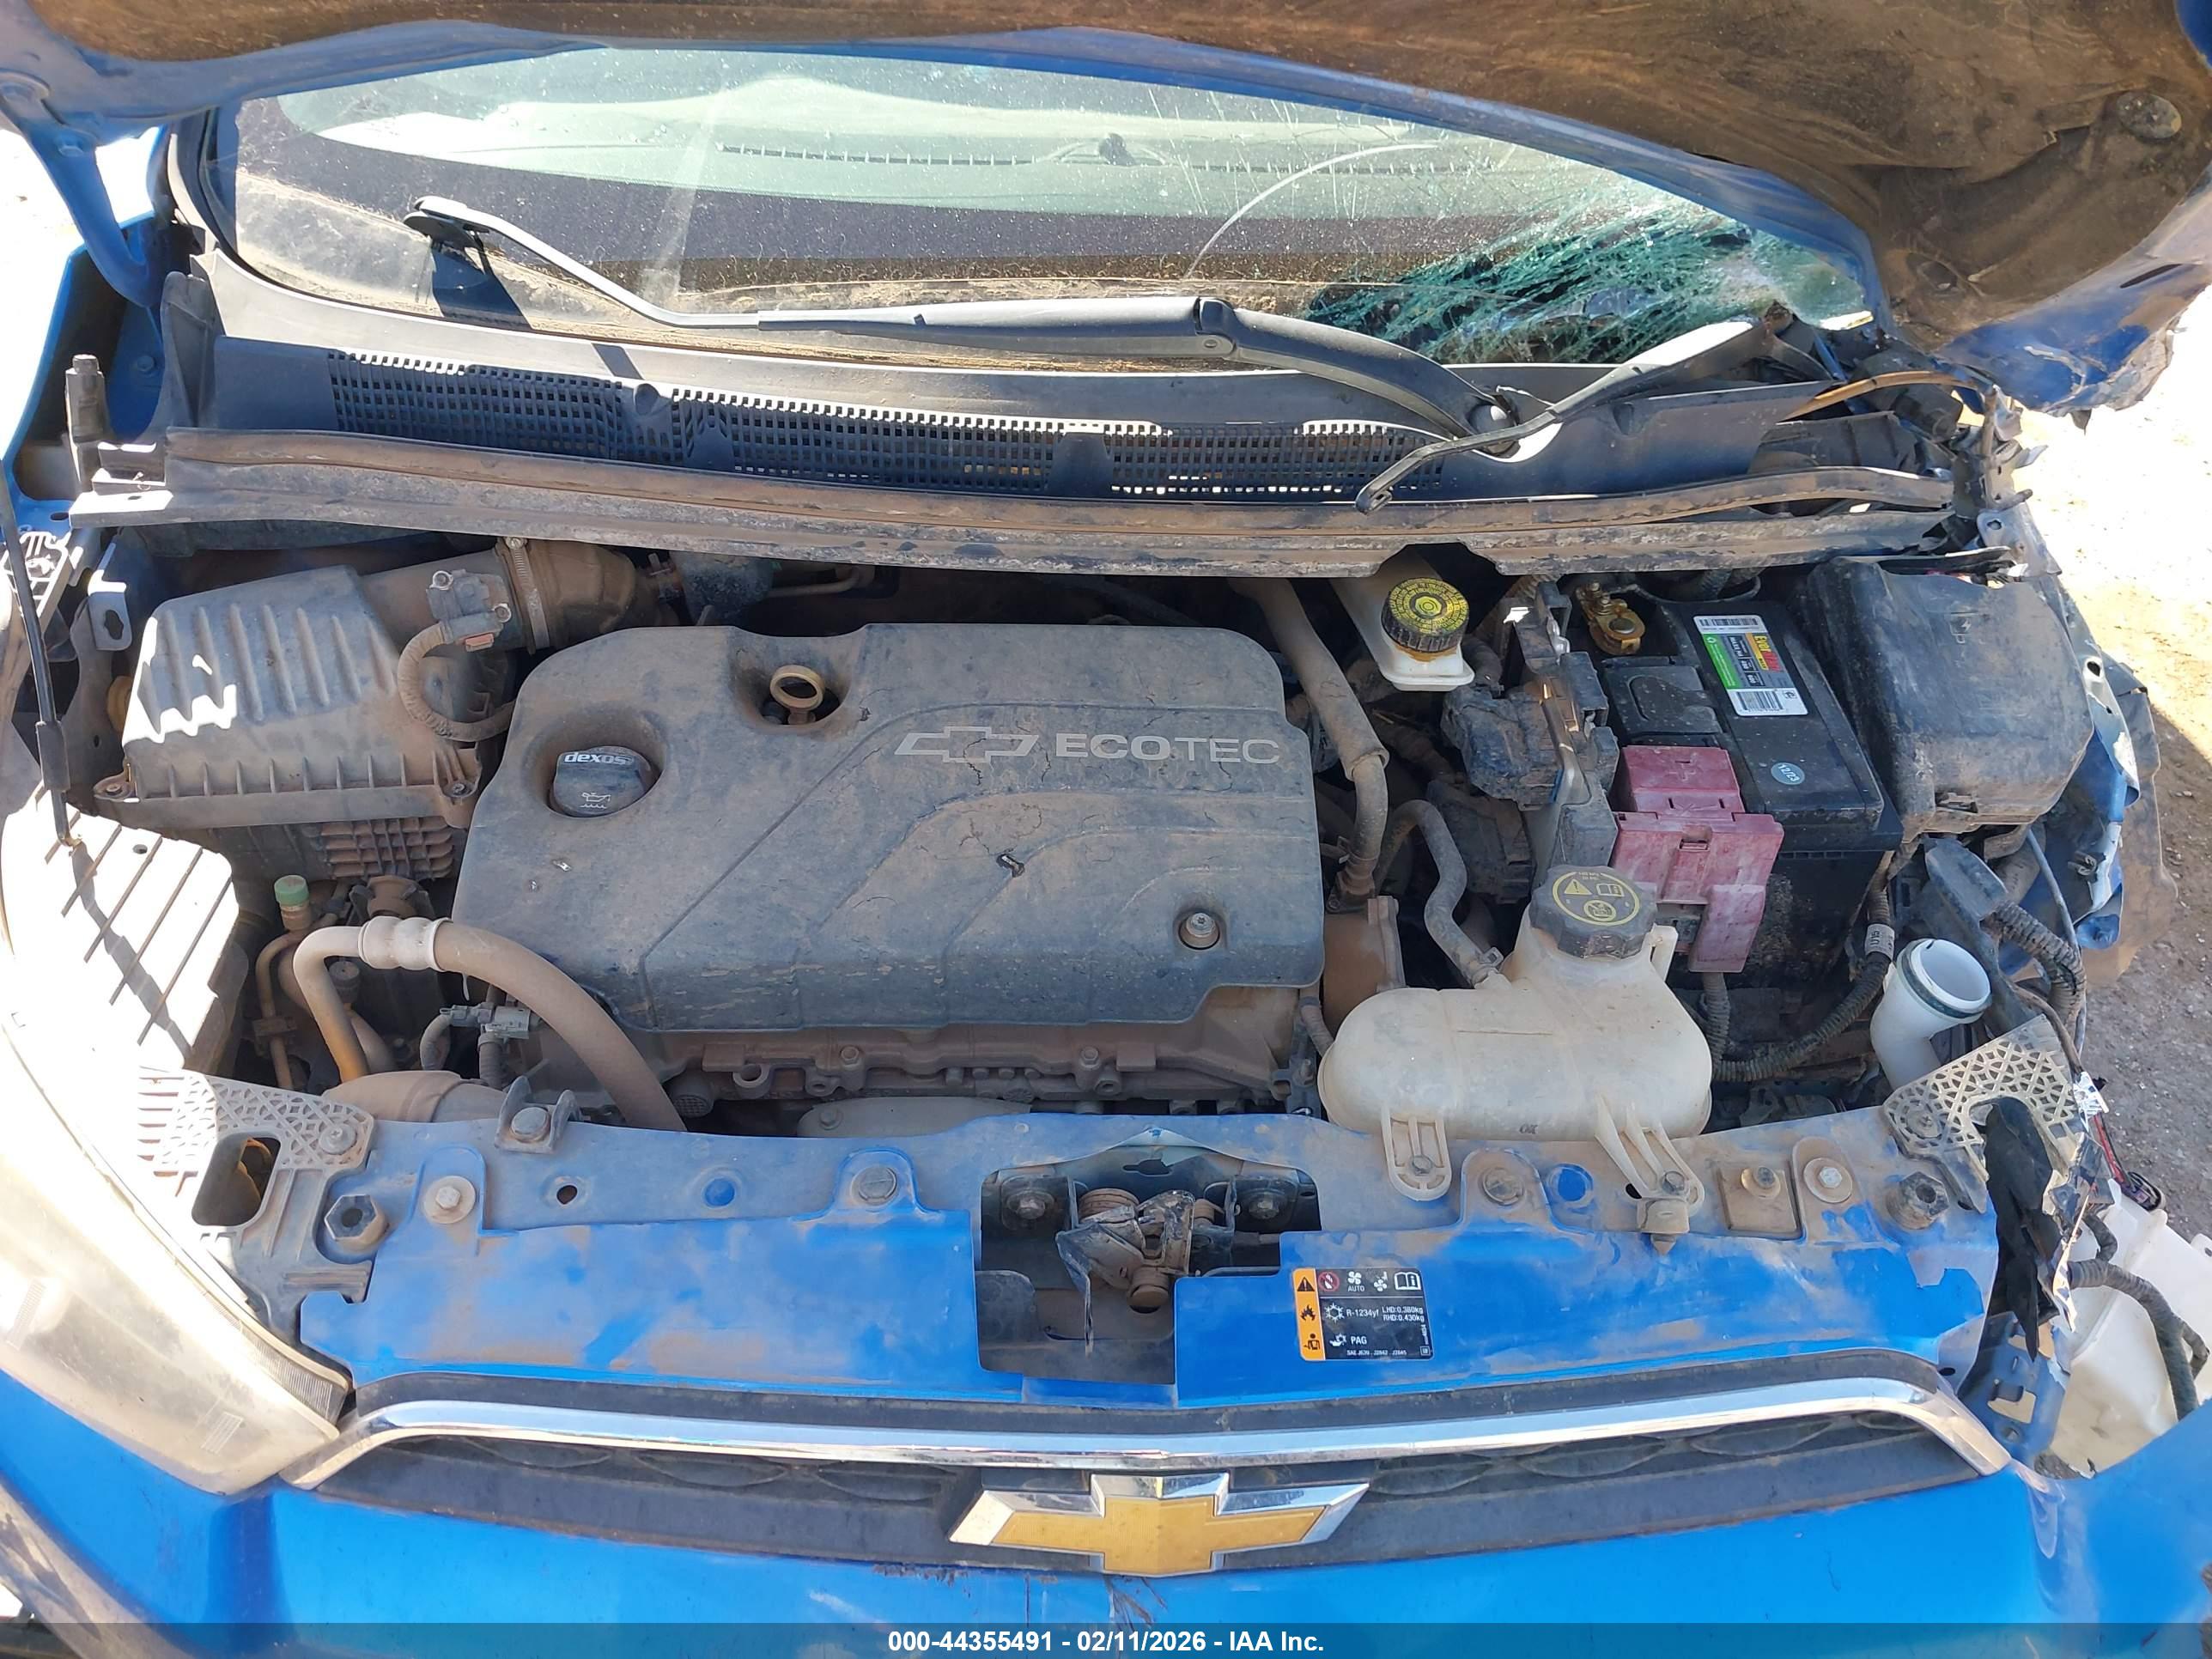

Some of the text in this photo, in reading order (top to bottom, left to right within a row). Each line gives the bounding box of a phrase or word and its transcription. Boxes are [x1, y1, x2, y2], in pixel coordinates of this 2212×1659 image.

[1055, 732, 1280, 764] ECOTEC
[564, 752, 633, 764] dexos
[1778, 764, 1801, 781] 12/23
[1346, 1309, 1378, 1317] R-1234yf
[1351, 1336, 1367, 1345] PAG
